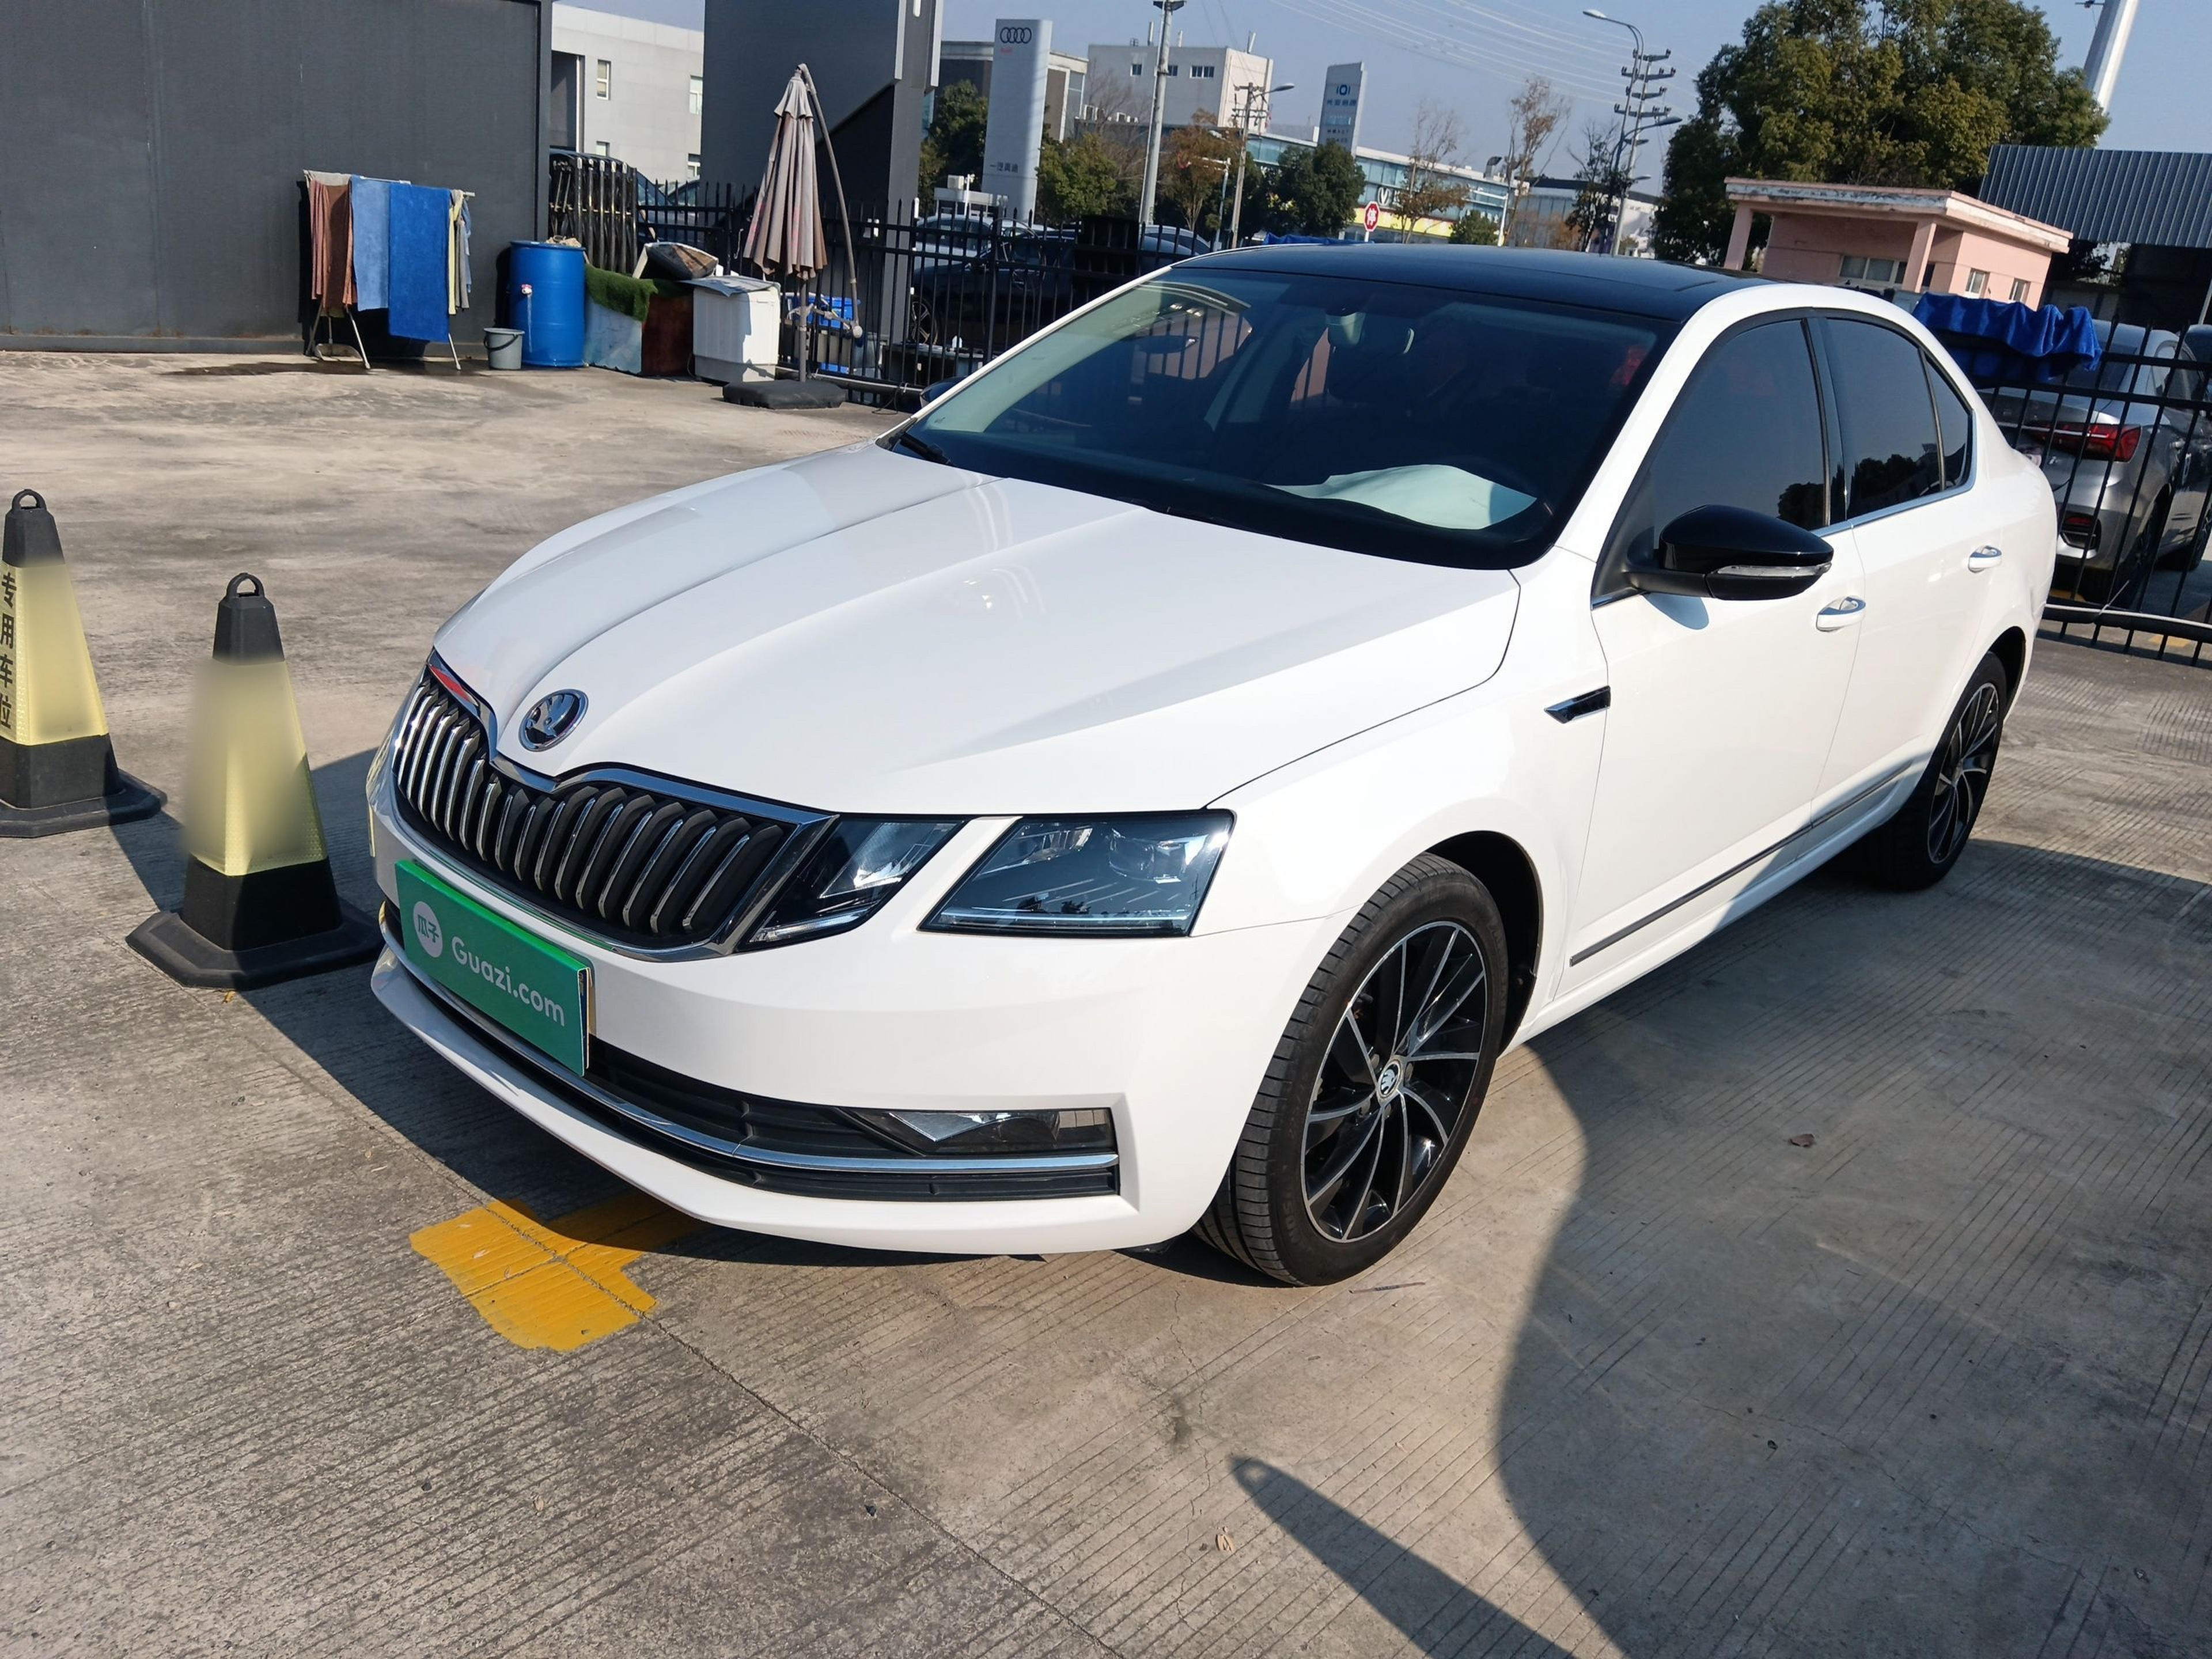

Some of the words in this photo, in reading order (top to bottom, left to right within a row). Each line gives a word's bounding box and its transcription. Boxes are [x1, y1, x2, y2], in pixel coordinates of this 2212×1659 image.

[1366, 207, 1377, 226] 停
[0, 572, 17, 729] 专用车位
[417, 914, 440, 944] 瓜子
[452, 935, 565, 1028] Guazi.com
